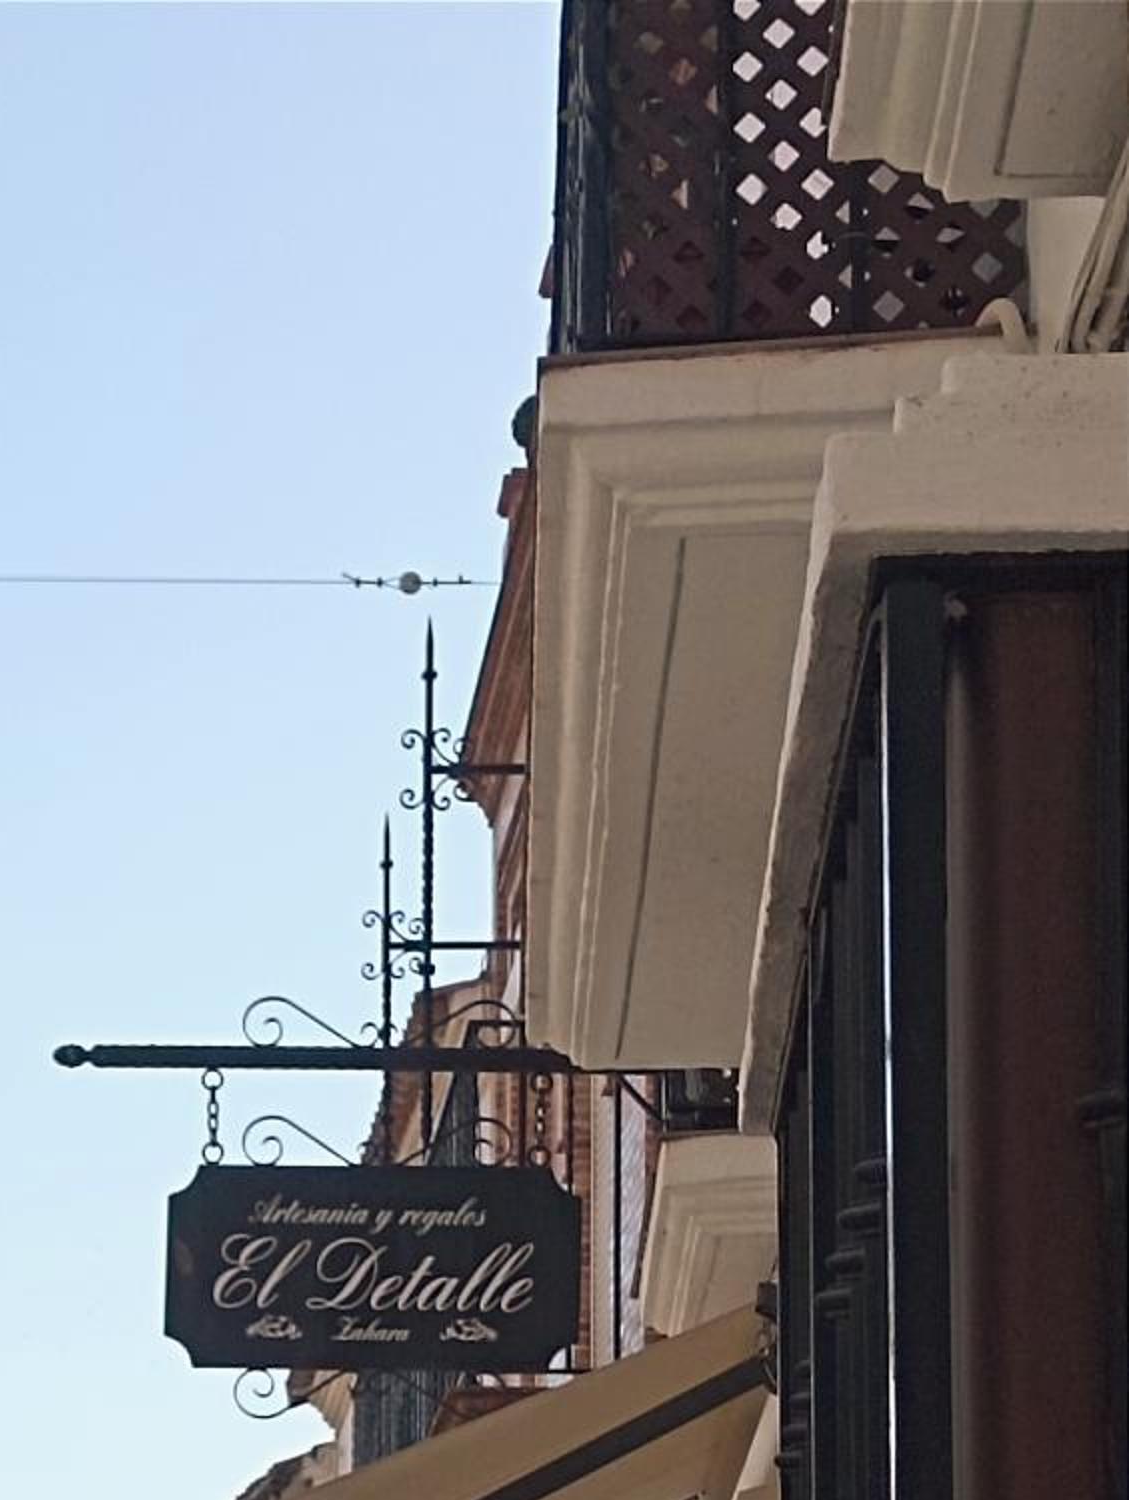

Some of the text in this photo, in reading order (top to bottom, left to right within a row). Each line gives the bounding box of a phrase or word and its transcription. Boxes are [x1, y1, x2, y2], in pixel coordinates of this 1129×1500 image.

[370, 1207, 393, 1235] y
[397, 1196, 488, 1237] regalos
[212, 1233, 535, 1314] El Detalle
[330, 1316, 411, 1341] Zahara
